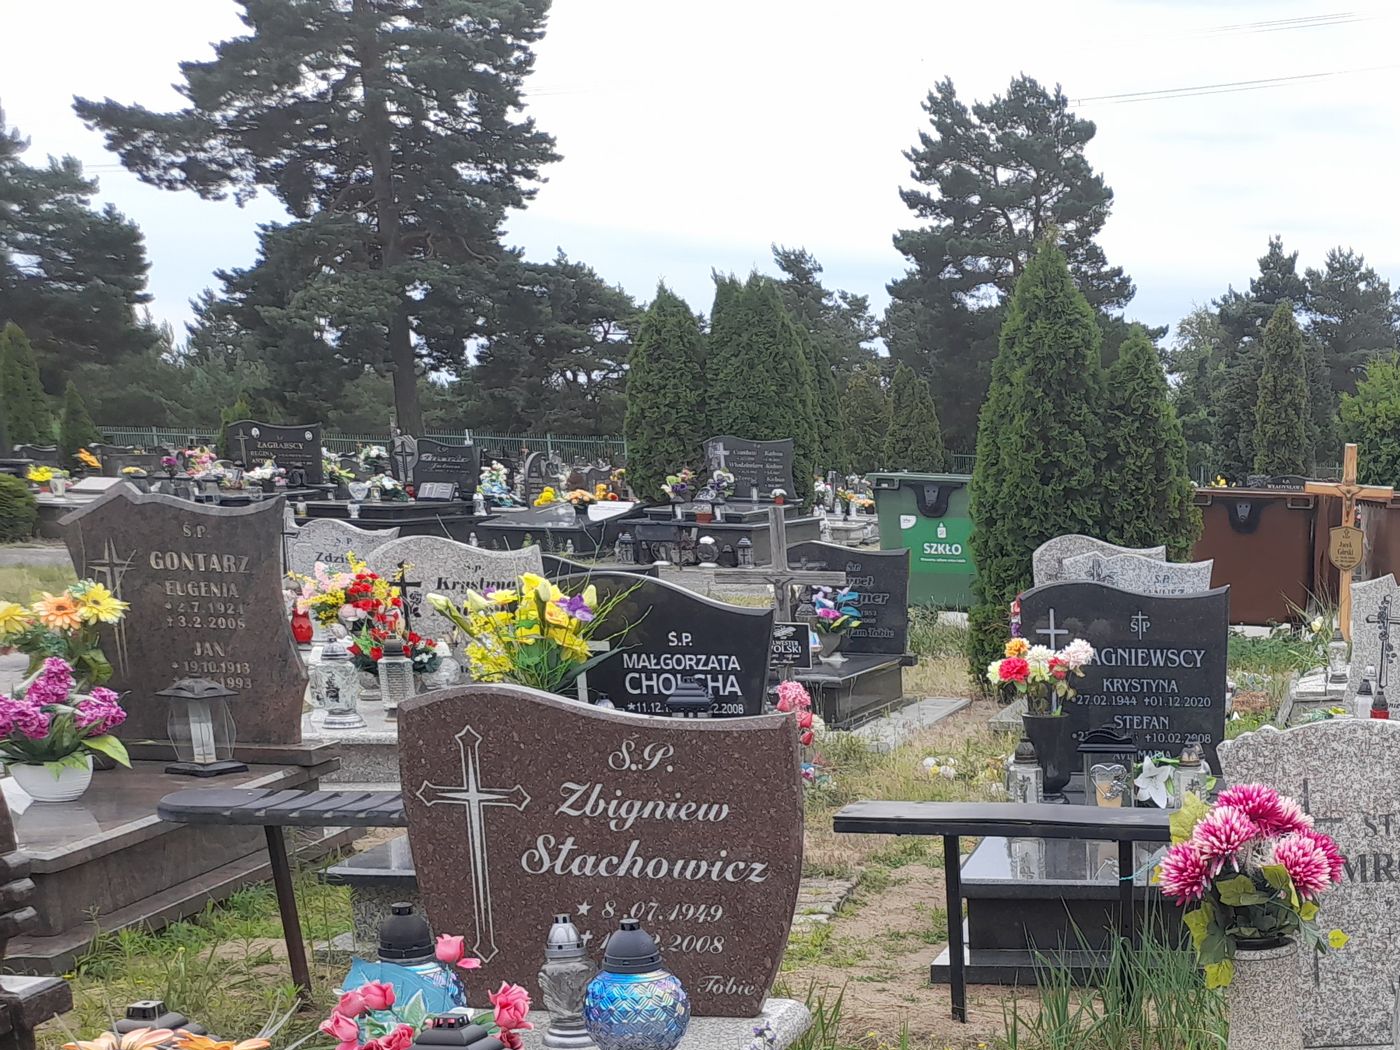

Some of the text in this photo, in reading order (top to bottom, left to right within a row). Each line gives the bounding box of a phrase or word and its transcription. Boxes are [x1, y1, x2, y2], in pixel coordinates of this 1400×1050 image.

[923, 542, 962, 555] SZKŁO
[150, 551, 250, 573] GONTARZ
[165, 580, 240, 598] EUGENIA
[668, 631, 693, 646] Ś.P.
[193, 642, 226, 657] JAN
[1089, 647, 1206, 668] AGNIEWSCY
[623, 653, 741, 671] MAŁGORZATA
[1103, 678, 1178, 693] KRYSTYNA
[1114, 715, 1169, 730] STEFAN
[555, 781, 730, 832] Zbigniew
[520, 834, 770, 883] Stachowicz
[697, 975, 755, 996] Tobie
